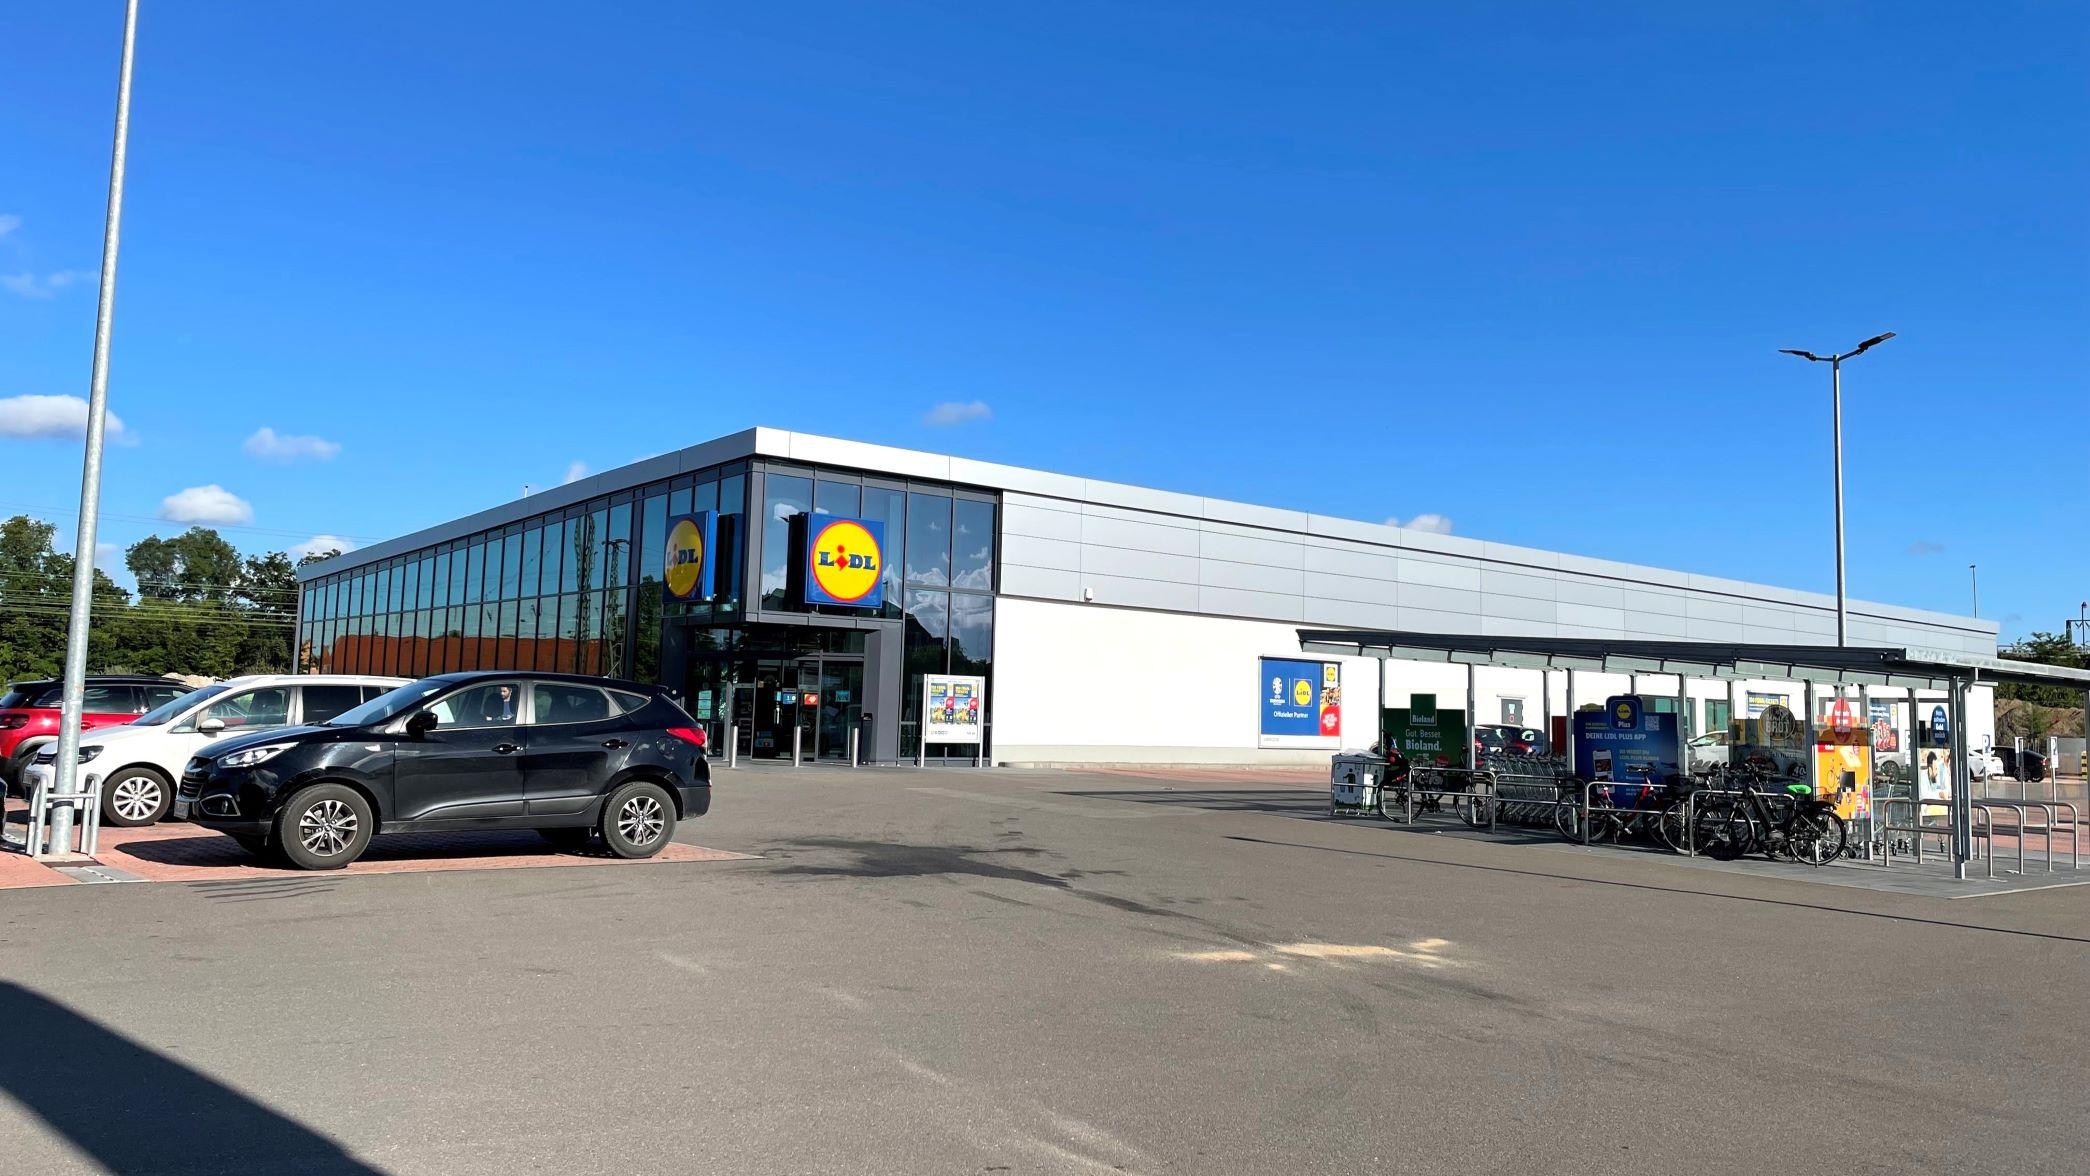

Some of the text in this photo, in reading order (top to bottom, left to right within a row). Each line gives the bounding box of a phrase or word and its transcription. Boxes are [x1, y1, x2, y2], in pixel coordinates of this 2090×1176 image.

[818, 544, 876, 571] LIDL
[1412, 714, 1435, 724] Bioland
[1420, 729, 1442, 739] Besser.
[1585, 732, 1647, 741] DEINE LIDL PLUS APP
[1405, 738, 1442, 751] Bioland.
